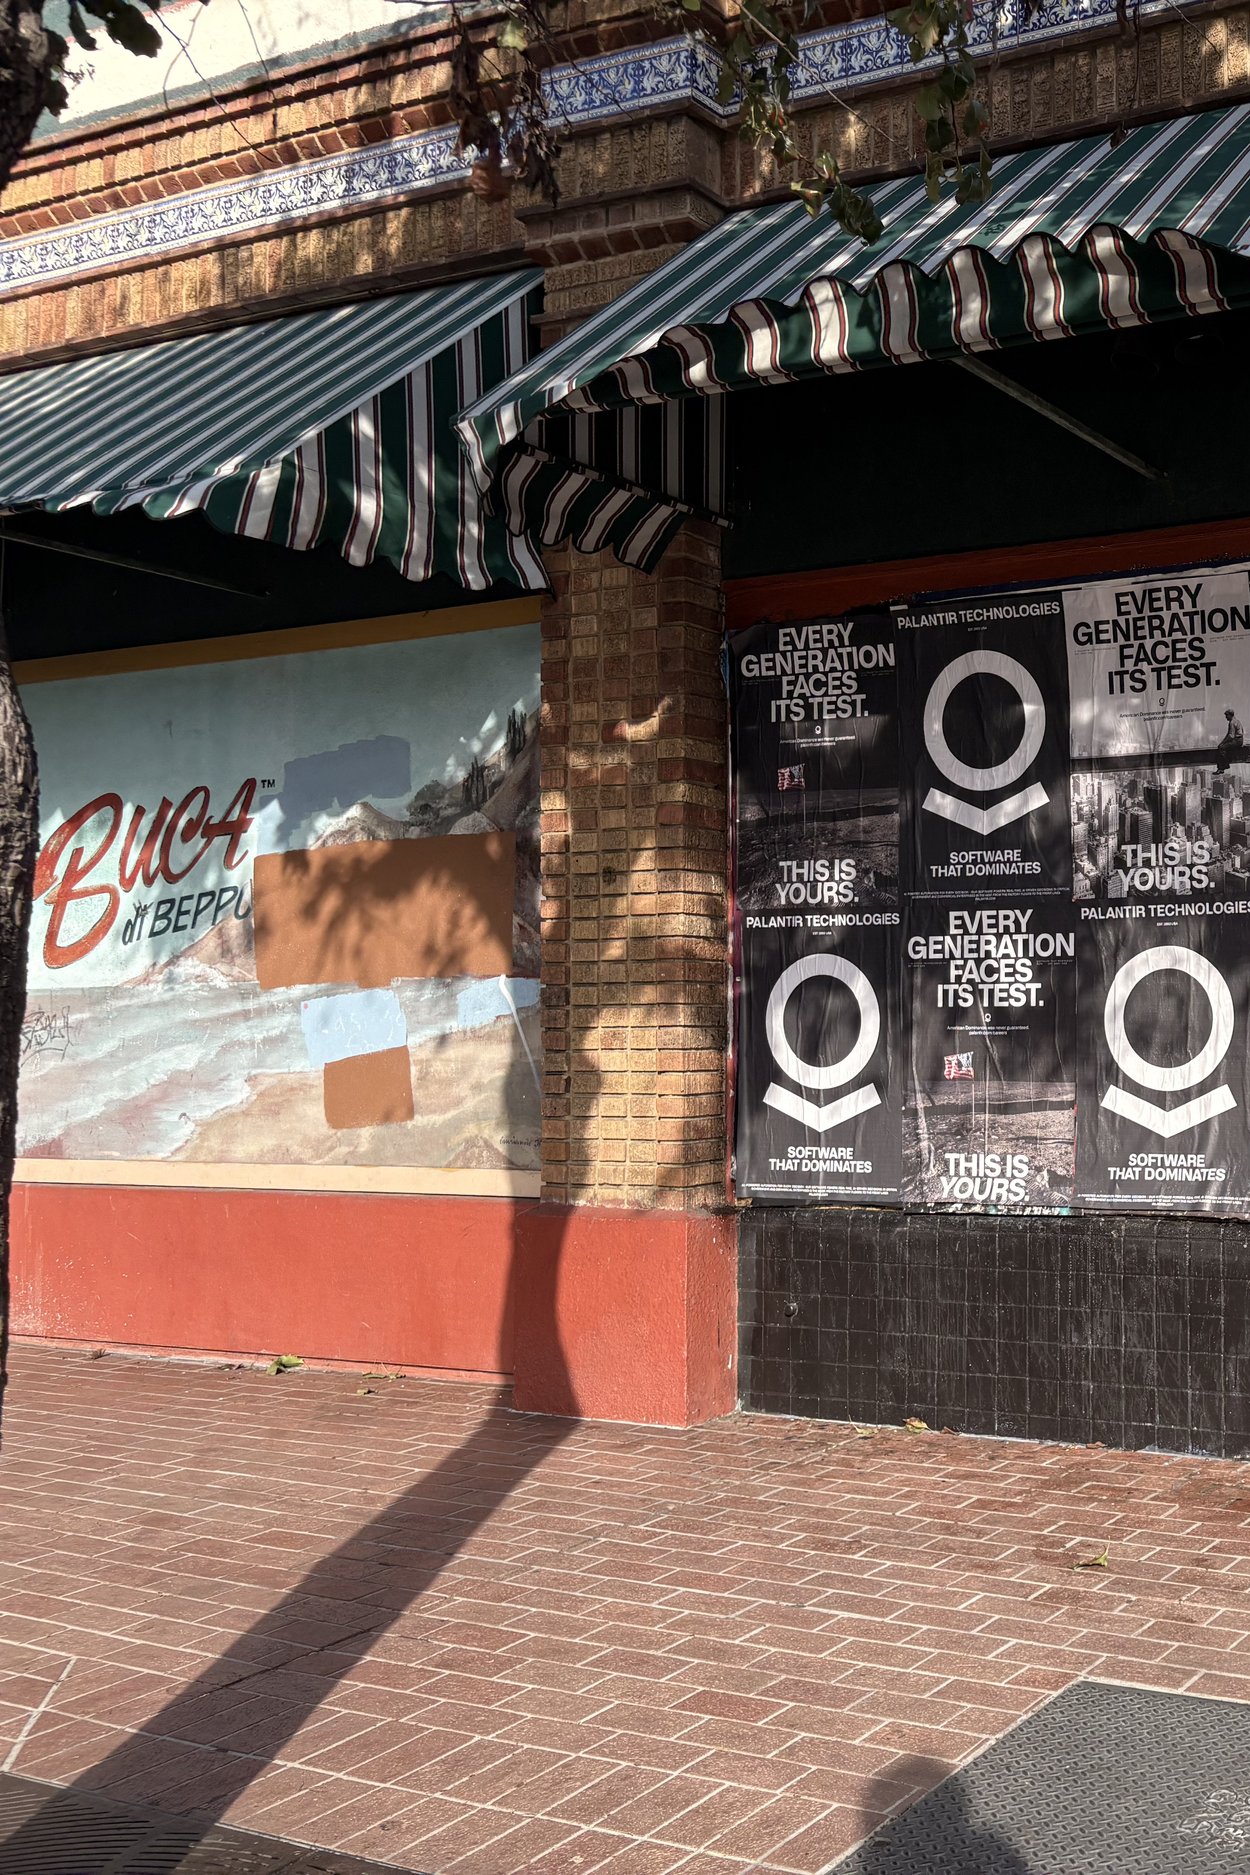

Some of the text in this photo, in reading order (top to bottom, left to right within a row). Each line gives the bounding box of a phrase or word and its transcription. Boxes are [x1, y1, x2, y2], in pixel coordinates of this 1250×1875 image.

[1115, 583, 1203, 617] EVERY
[897, 602, 1060, 629] PALANTIR TECHNOLOGIES
[1073, 605, 1250, 646] GENERATION
[779, 622, 854, 651] EVERY
[741, 643, 895, 677] GENERATION
[1119, 637, 1206, 668] FACES
[782, 671, 858, 698] FACES
[1108, 662, 1220, 695] ITS TEST.
[770, 694, 868, 722] ITS TEST.
[949, 849, 1022, 864] SOFTWARE
[1120, 841, 1211, 867] THIS IS
[779, 859, 856, 882] THIS IS
[930, 862, 1041, 877] THAT DOMINATES
[1118, 865, 1215, 891] YOURS.
[775, 881, 859, 905] YOURS.
[746, 913, 900, 928] PALANTIR TECHNOLOGIES
[949, 909, 1033, 934] EVERY
[1080, 905, 1146, 920] PALANTIR
[908, 933, 1075, 959] GENERATION
[950, 958, 1033, 983] FACES
[937, 983, 1044, 1007] ITS TEST.
[787, 1146, 854, 1160] SOFTWARE
[944, 1152, 1029, 1178] THIS IS
[1128, 1153, 1205, 1167] SOFTWARE
[769, 1158, 873, 1174] THAT DOMINATES
[1108, 1167, 1226, 1182] THAT DOMINATES
[940, 1177, 1030, 1202] YOURS.
